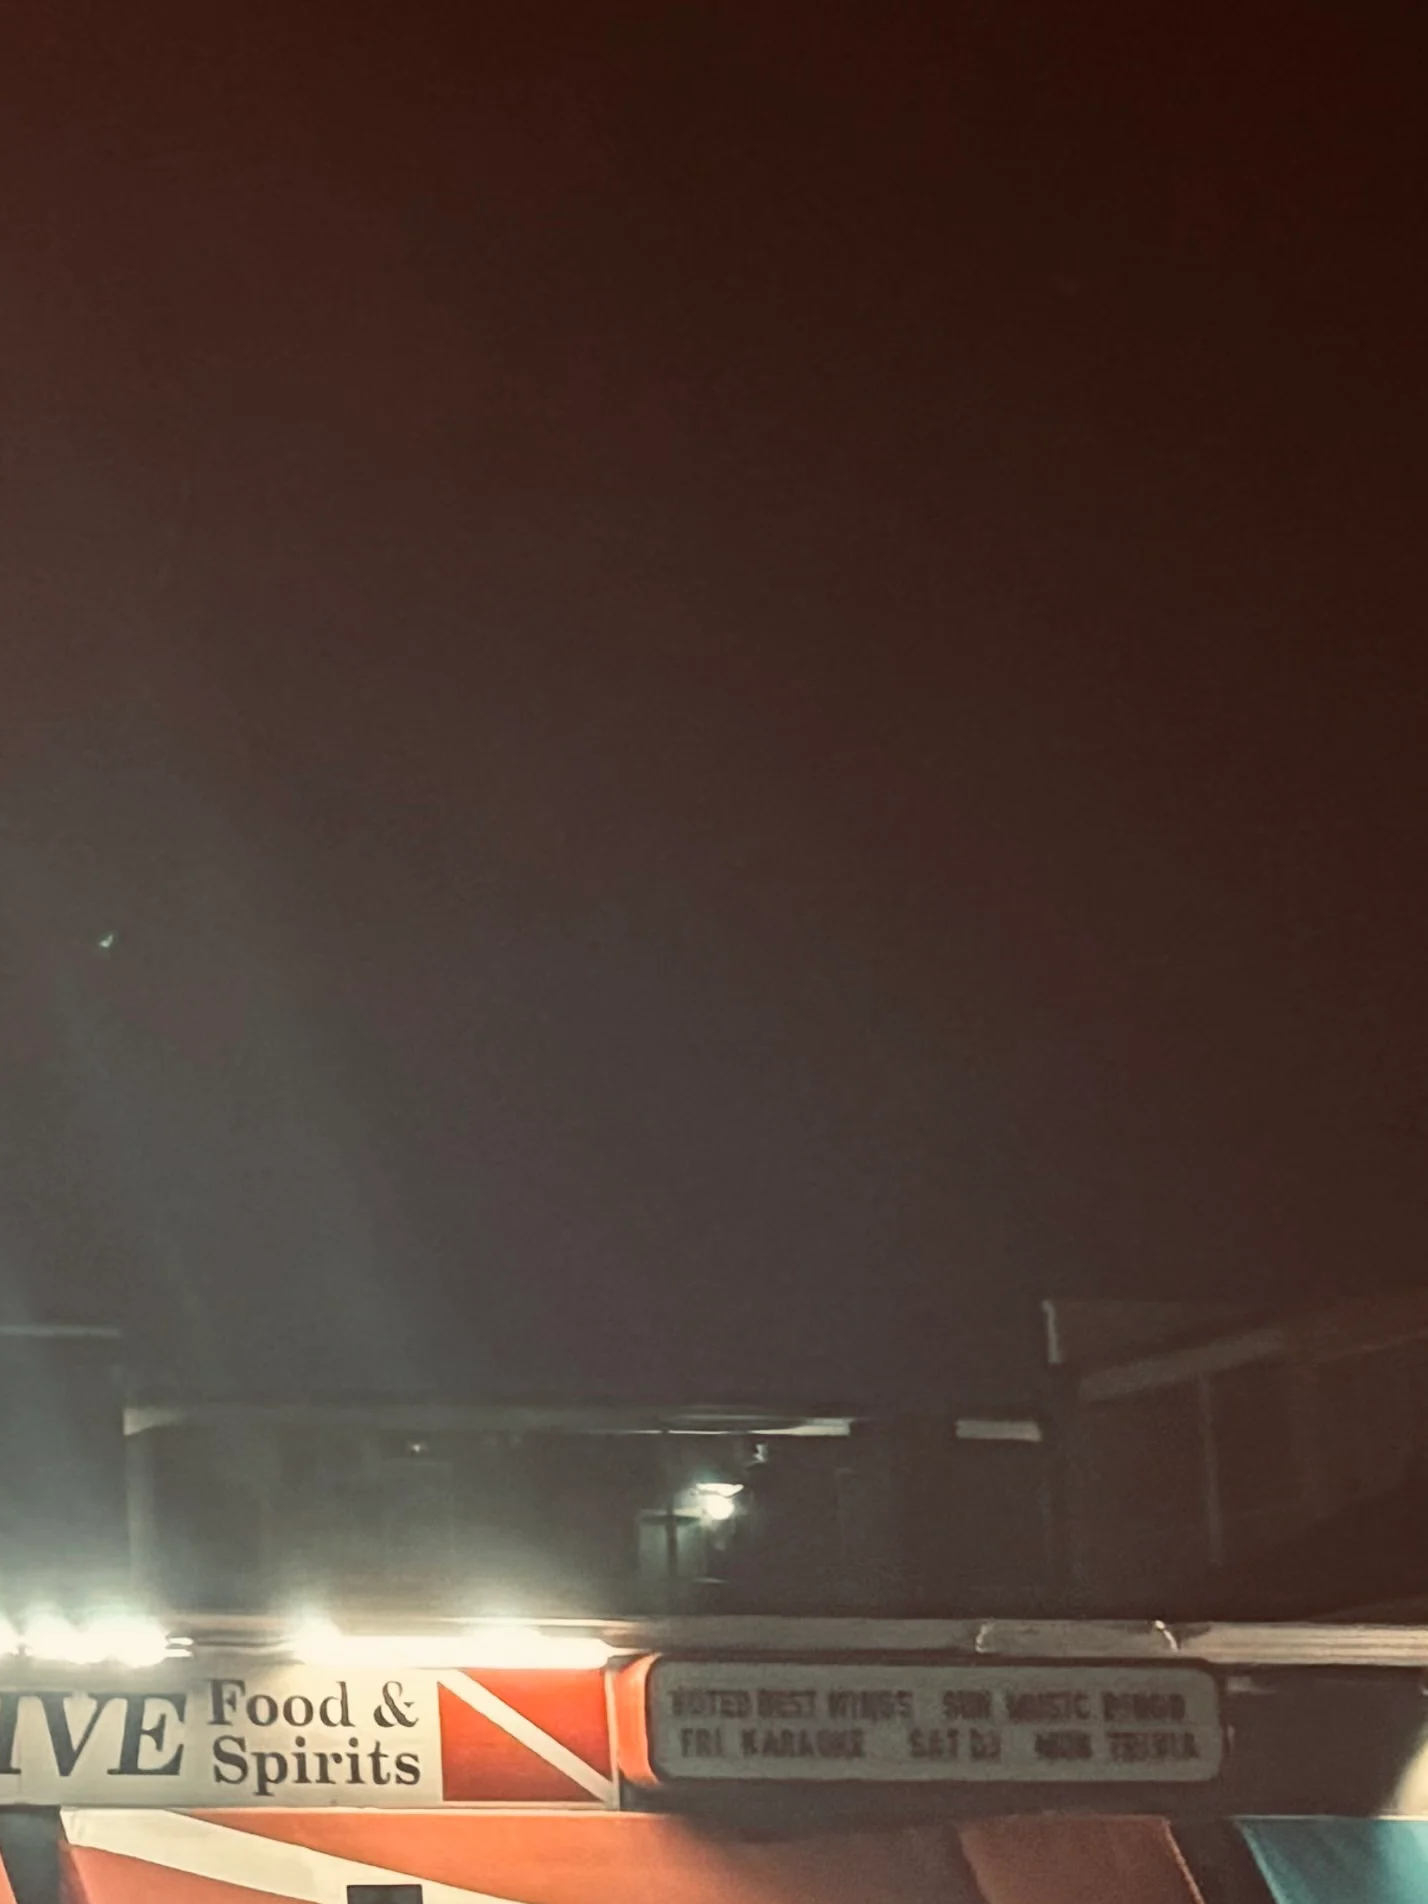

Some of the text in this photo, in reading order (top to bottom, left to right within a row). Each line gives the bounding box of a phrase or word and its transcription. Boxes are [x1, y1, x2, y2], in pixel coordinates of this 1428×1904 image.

[208, 1678, 419, 1729] Food &
[210, 1735, 422, 1797] Spirits
[681, 1727, 724, 1758] FRI
